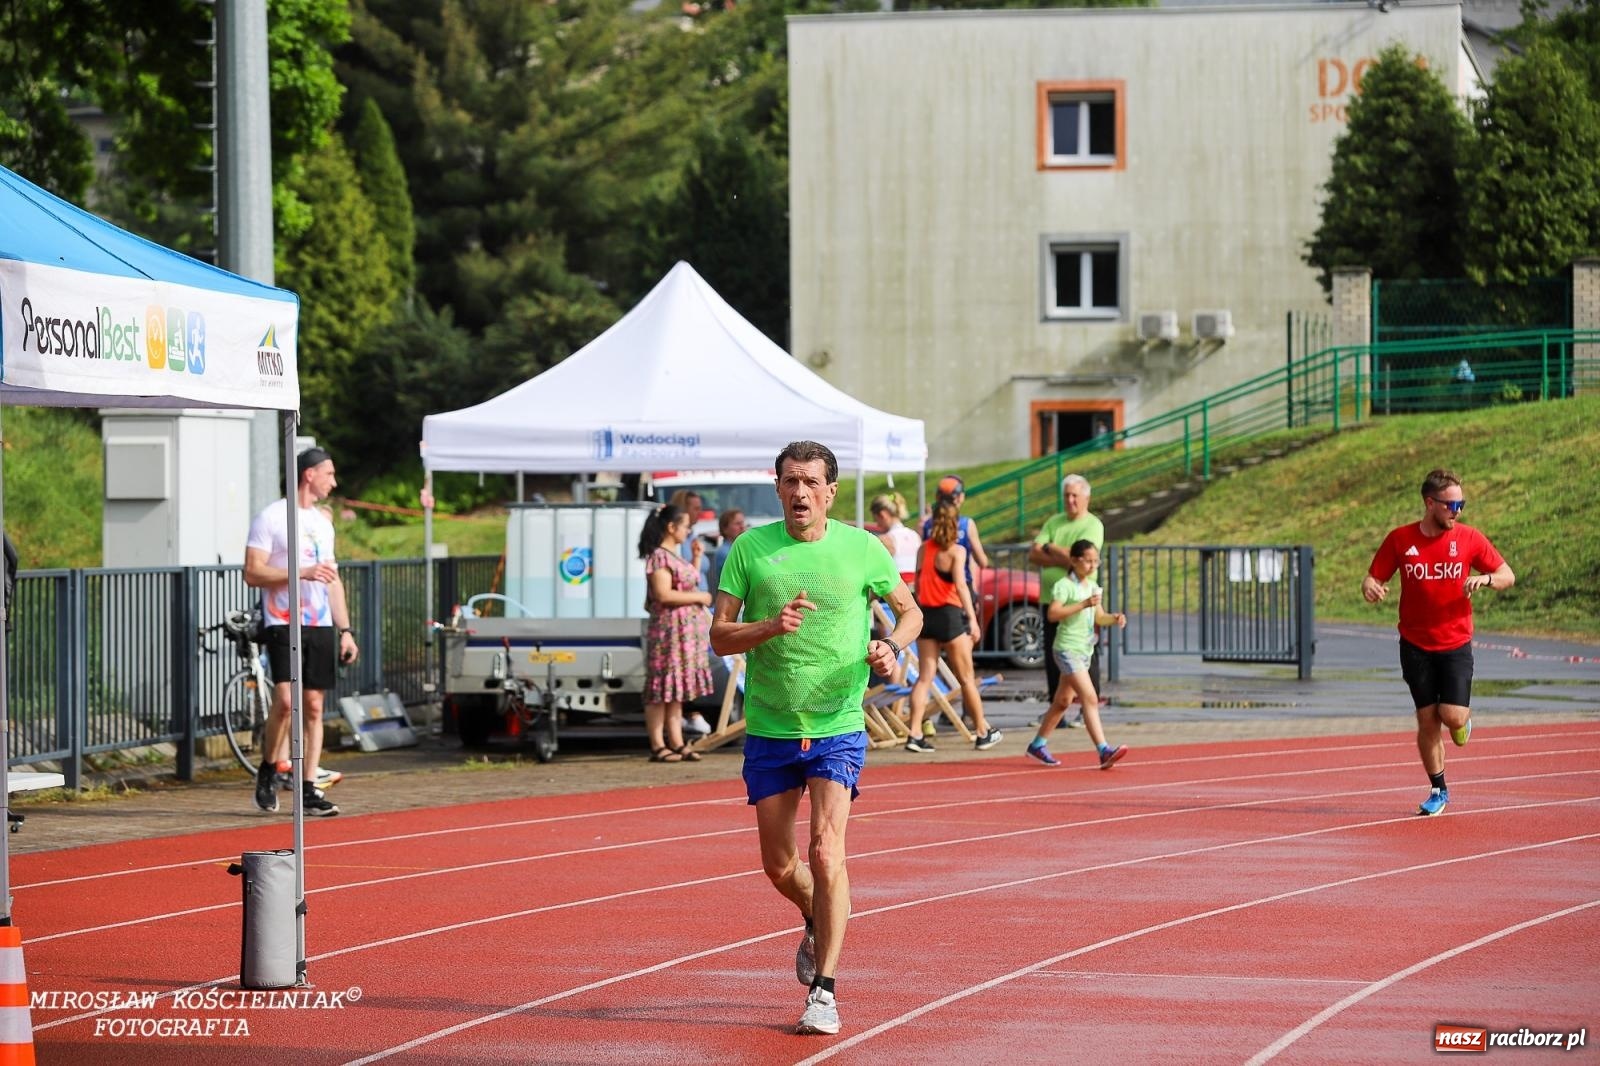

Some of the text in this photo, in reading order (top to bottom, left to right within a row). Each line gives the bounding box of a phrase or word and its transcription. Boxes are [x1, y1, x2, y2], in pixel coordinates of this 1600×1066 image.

[1309, 103, 1351, 123] SPO
[21, 297, 141, 361] PersonalBest
[257, 350, 284, 376] MITKO
[620, 434, 700, 447] Wodociągi
[1405, 562, 1463, 580] POLSKA
